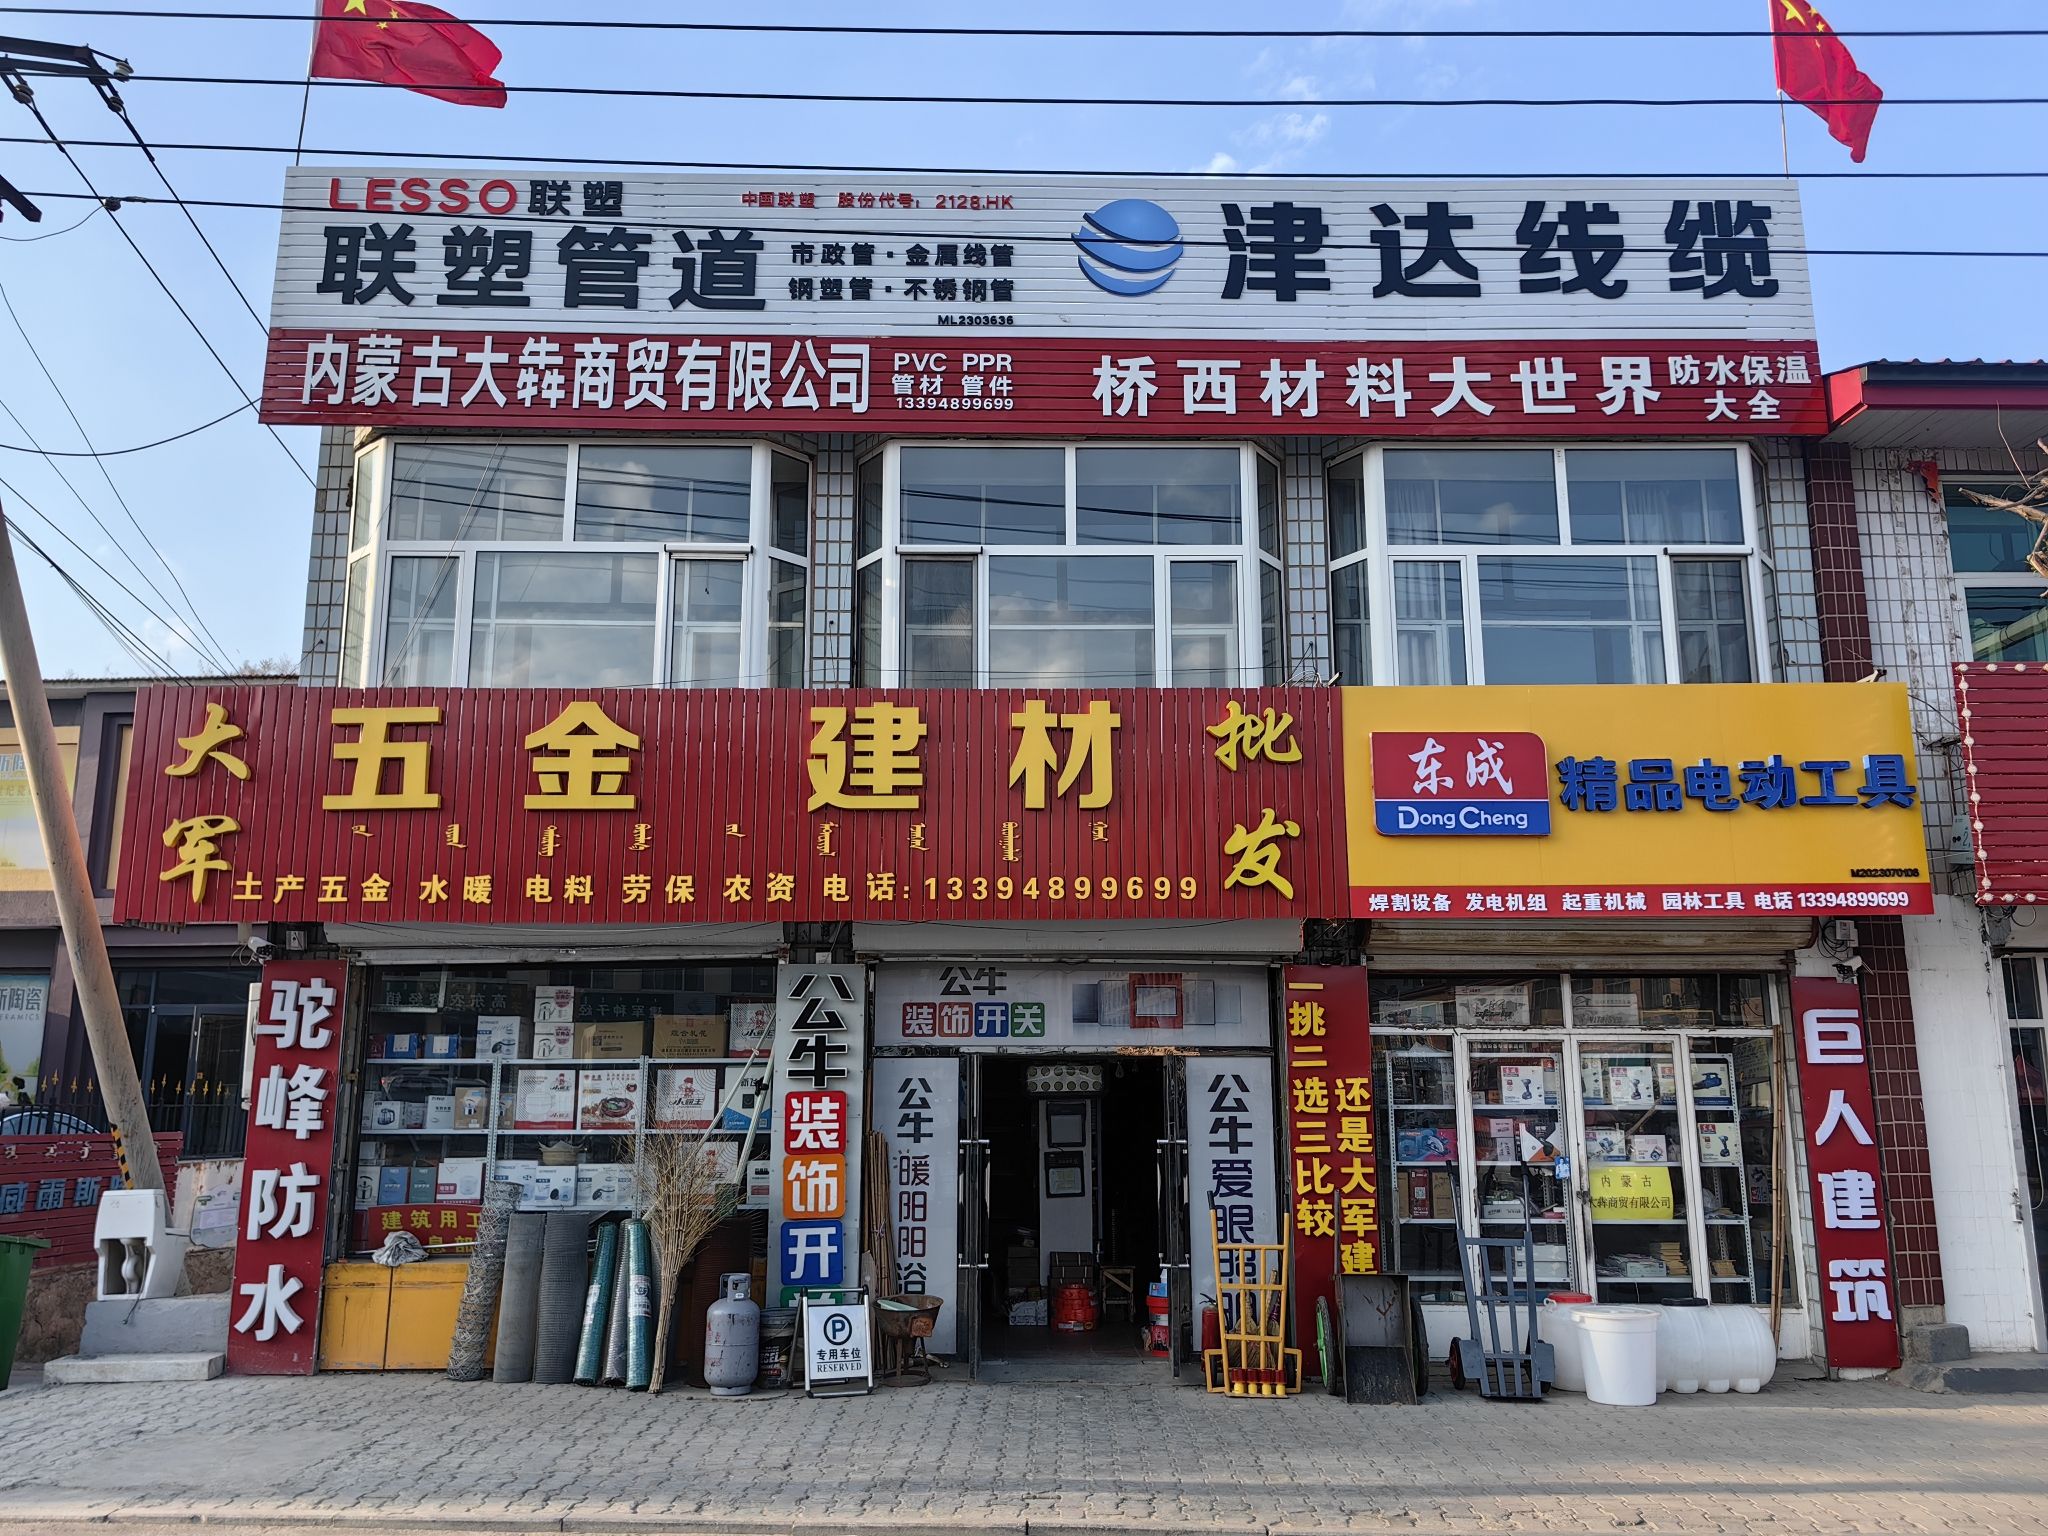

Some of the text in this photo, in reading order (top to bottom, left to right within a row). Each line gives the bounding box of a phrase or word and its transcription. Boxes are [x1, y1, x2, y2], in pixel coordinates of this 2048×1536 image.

[328, 177, 624, 217] LESSO 联塑
[742, 191, 816, 209] 中国联塑
[316, 222, 766, 310] 联塑管道
[1220, 199, 1780, 302] 津达线缆
[938, 314, 1014, 326] ML2303636
[301, 332, 870, 414] 内蒙古大犇商贸有限公司
[893, 352, 1013, 373] PVC PPR
[1667, 354, 1812, 386] 防水保温
[891, 373, 1014, 398] 管材 管件
[1092, 354, 1661, 419] 桥西材料大世界
[896, 396, 1014, 410] 13394899699
[1704, 390, 1781, 422] 大全
[1407, 737, 1515, 796] 东成
[1555, 753, 1918, 813] 精品电动工具
[1206, 700, 1302, 901] 批发
[232, 872, 391, 904] 土产五金
[419, 873, 493, 905] 水暖
[525, 873, 595, 905] 电料
[622, 873, 696, 905] 劳保
[723, 872, 796, 904] 农资
[1369, 893, 1452, 913] 焊割设备
[1465, 893, 1548, 913] 发电机组
[1561, 892, 1647, 912] 起重机械
[1661, 891, 1746, 911] 园林工具
[938, 966, 1008, 997] 公牛
[902, 1002, 1045, 1037] 装饰开关
[1287, 981, 1336, 1238] 一挑二选三比较
[234, 977, 337, 1342] 驼峰防水
[1802, 1008, 1892, 1323] 巨人建筑
[1601, 1174, 1652, 1188] 内蒙古
[816, 1347, 862, 1361] 专用车位
[816, 1362, 862, 1373] RESERVED
